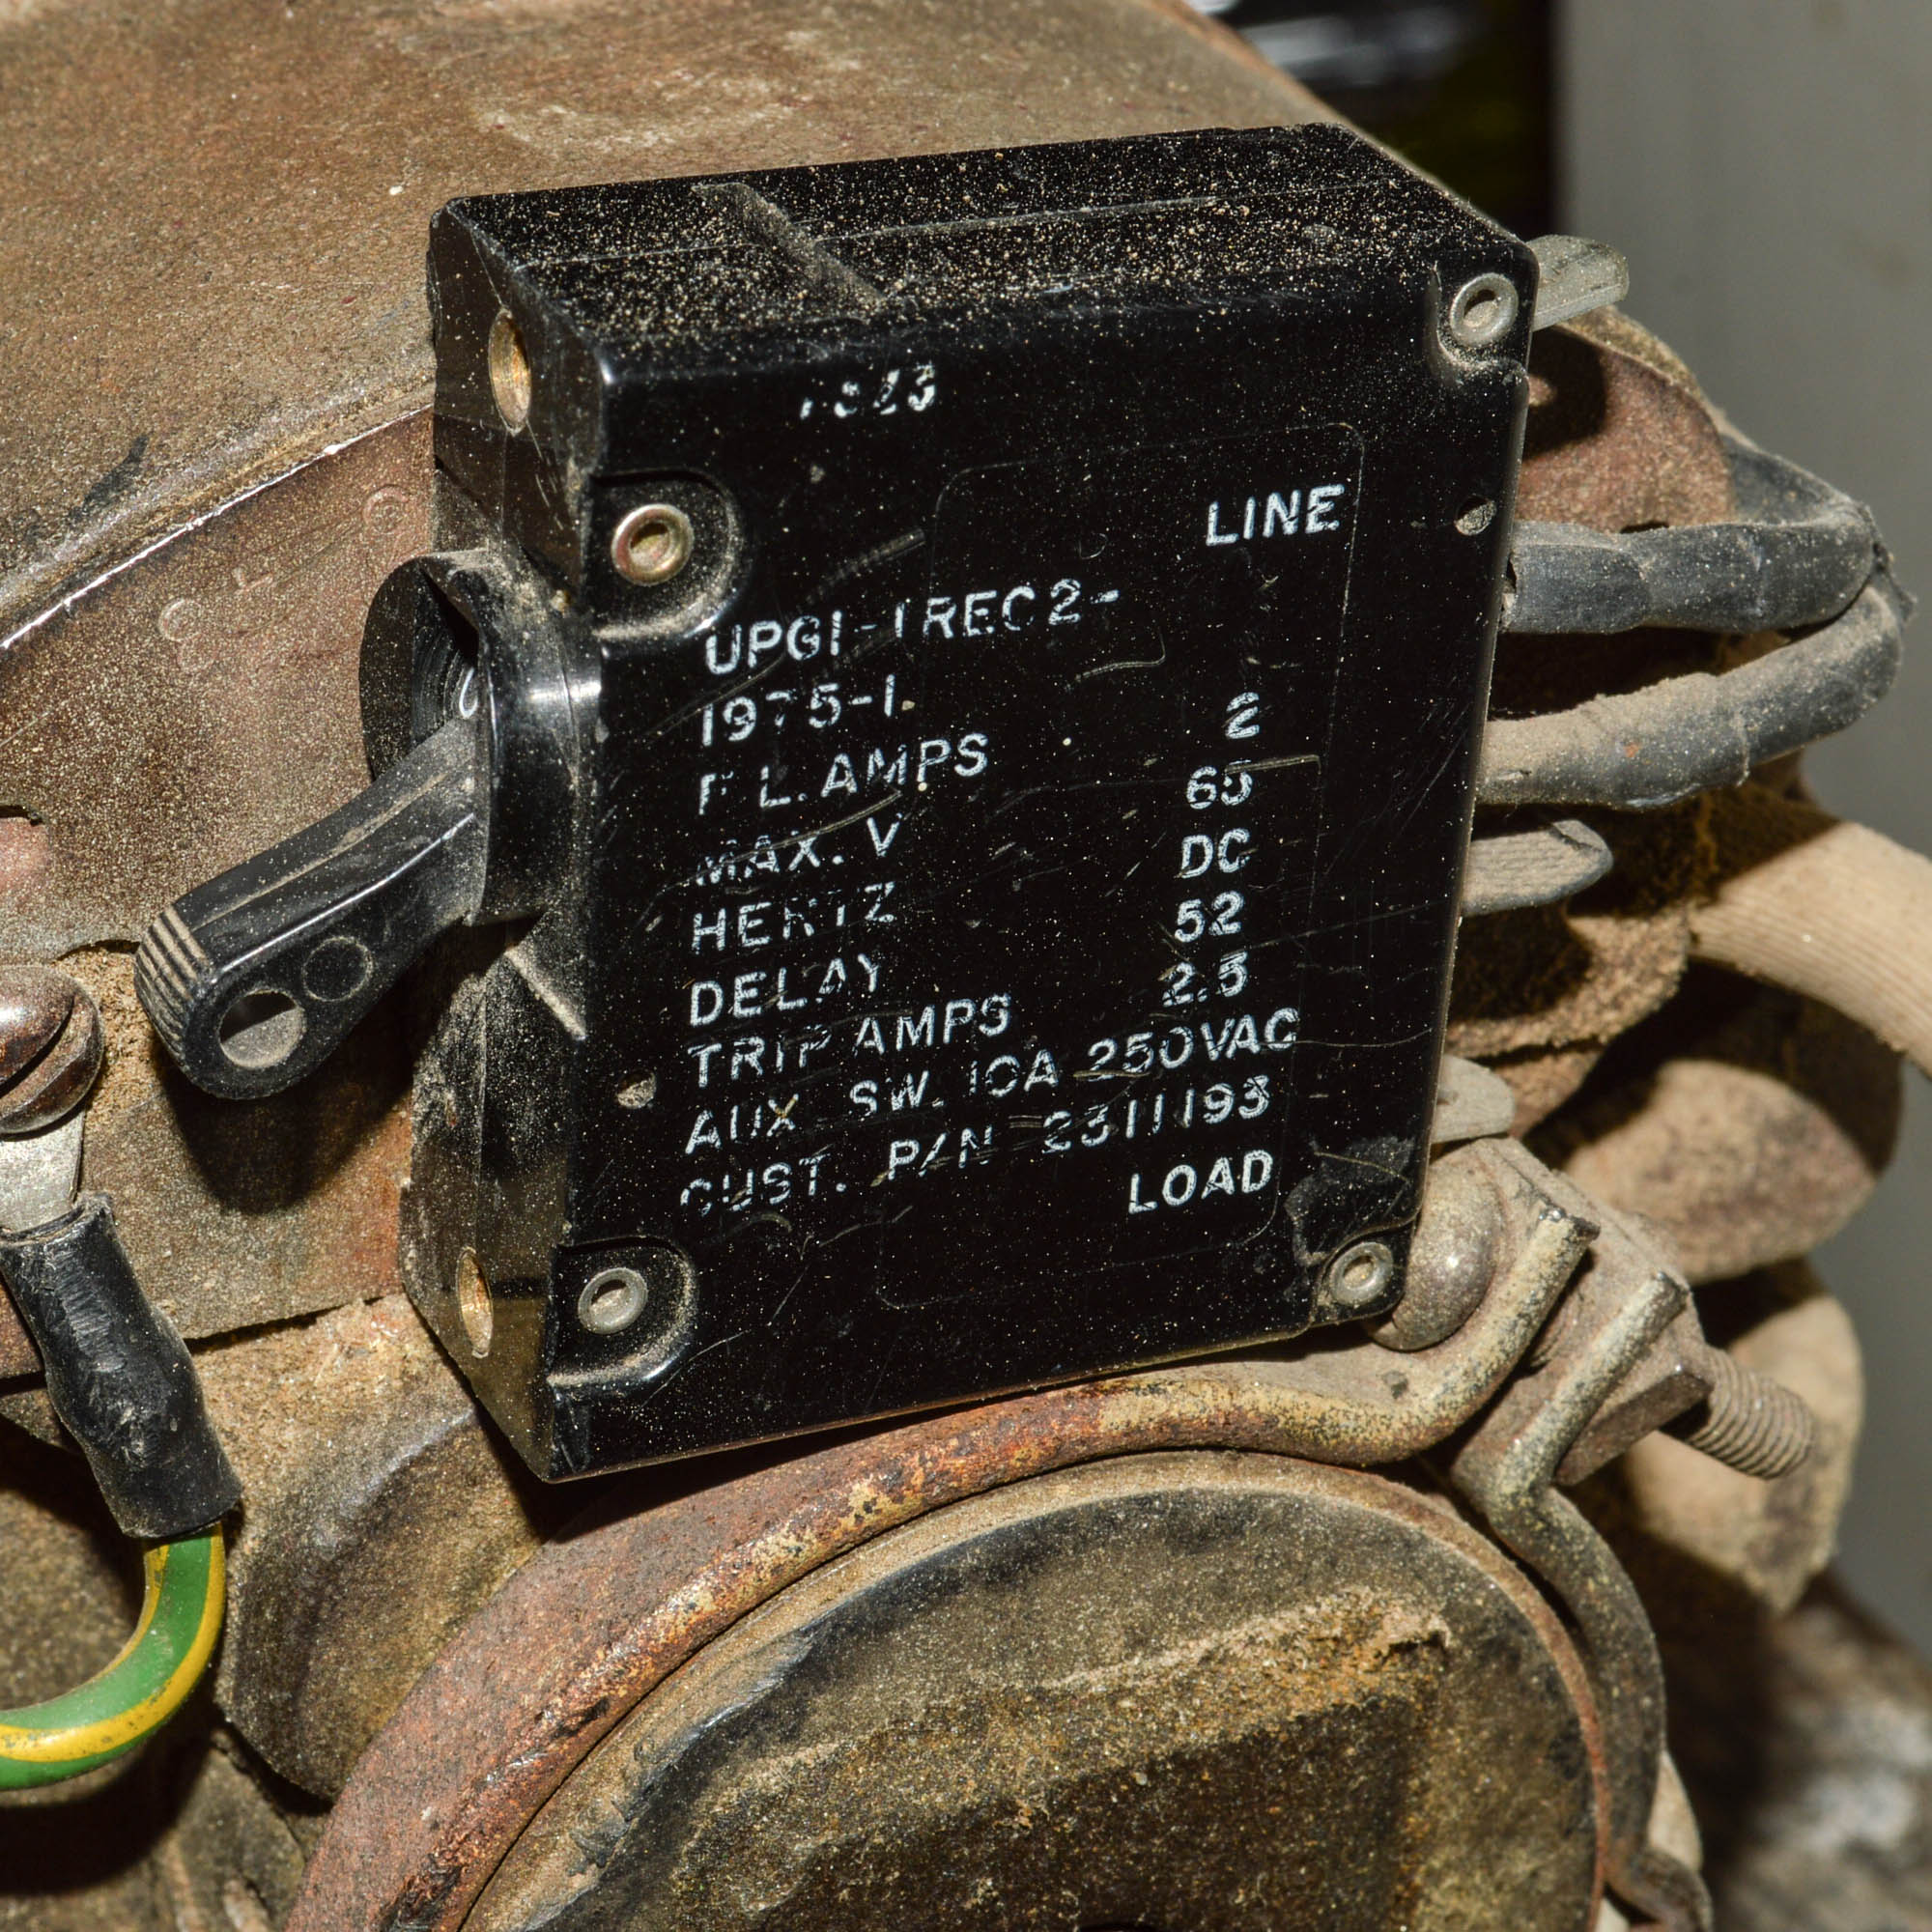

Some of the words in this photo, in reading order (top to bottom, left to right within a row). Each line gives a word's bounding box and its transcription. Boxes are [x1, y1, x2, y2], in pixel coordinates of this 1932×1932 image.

[1206, 484, 1346, 546] LINE
[1225, 692, 1260, 739] 2
[867, 811, 903, 857] V
[692, 880, 895, 953] HERTZ
[1180, 828, 1250, 879] DC
[690, 953, 879, 1027] DELAY
[1175, 891, 1245, 943] 52
[687, 1024, 832, 1088] TRIP
[853, 992, 1012, 1056] AMPS
[1162, 952, 1248, 1007] 2.5
[848, 1070, 945, 1118] SW.
[1087, 1007, 1298, 1082] 250VAC
[680, 1153, 847, 1216] CUST.
[888, 1125, 994, 1180] P/N
[1042, 1074, 1270, 1154] 2311193
[1128, 1150, 1273, 1214] LOAD
